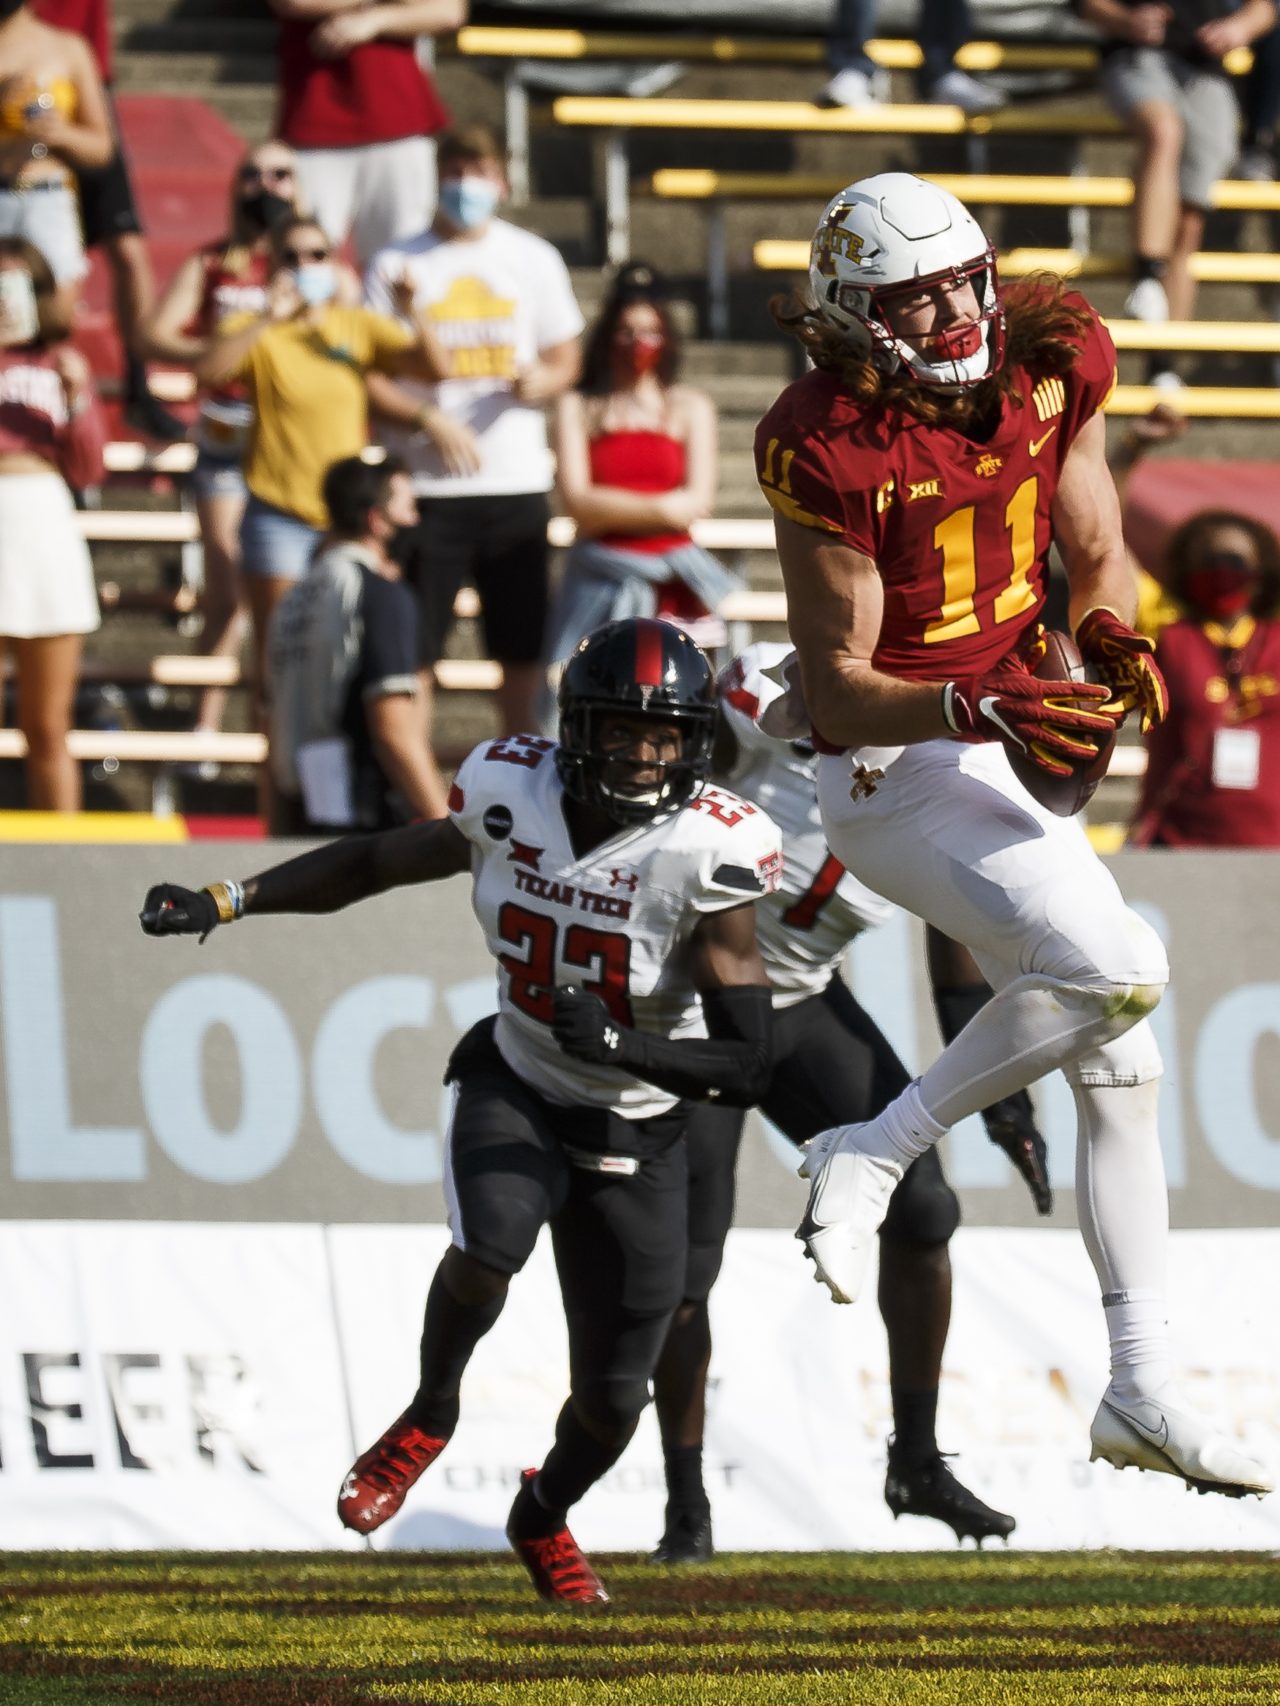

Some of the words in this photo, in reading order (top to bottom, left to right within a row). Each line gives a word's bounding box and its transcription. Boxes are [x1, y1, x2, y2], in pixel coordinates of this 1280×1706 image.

[760, 437, 797, 495] 11
[923, 475, 1039, 645] 11
[513, 867, 576, 907] TEXAS
[579, 888, 633, 920] TECH
[499, 901, 637, 1032] 23
[2, 894, 503, 1184] Loc
